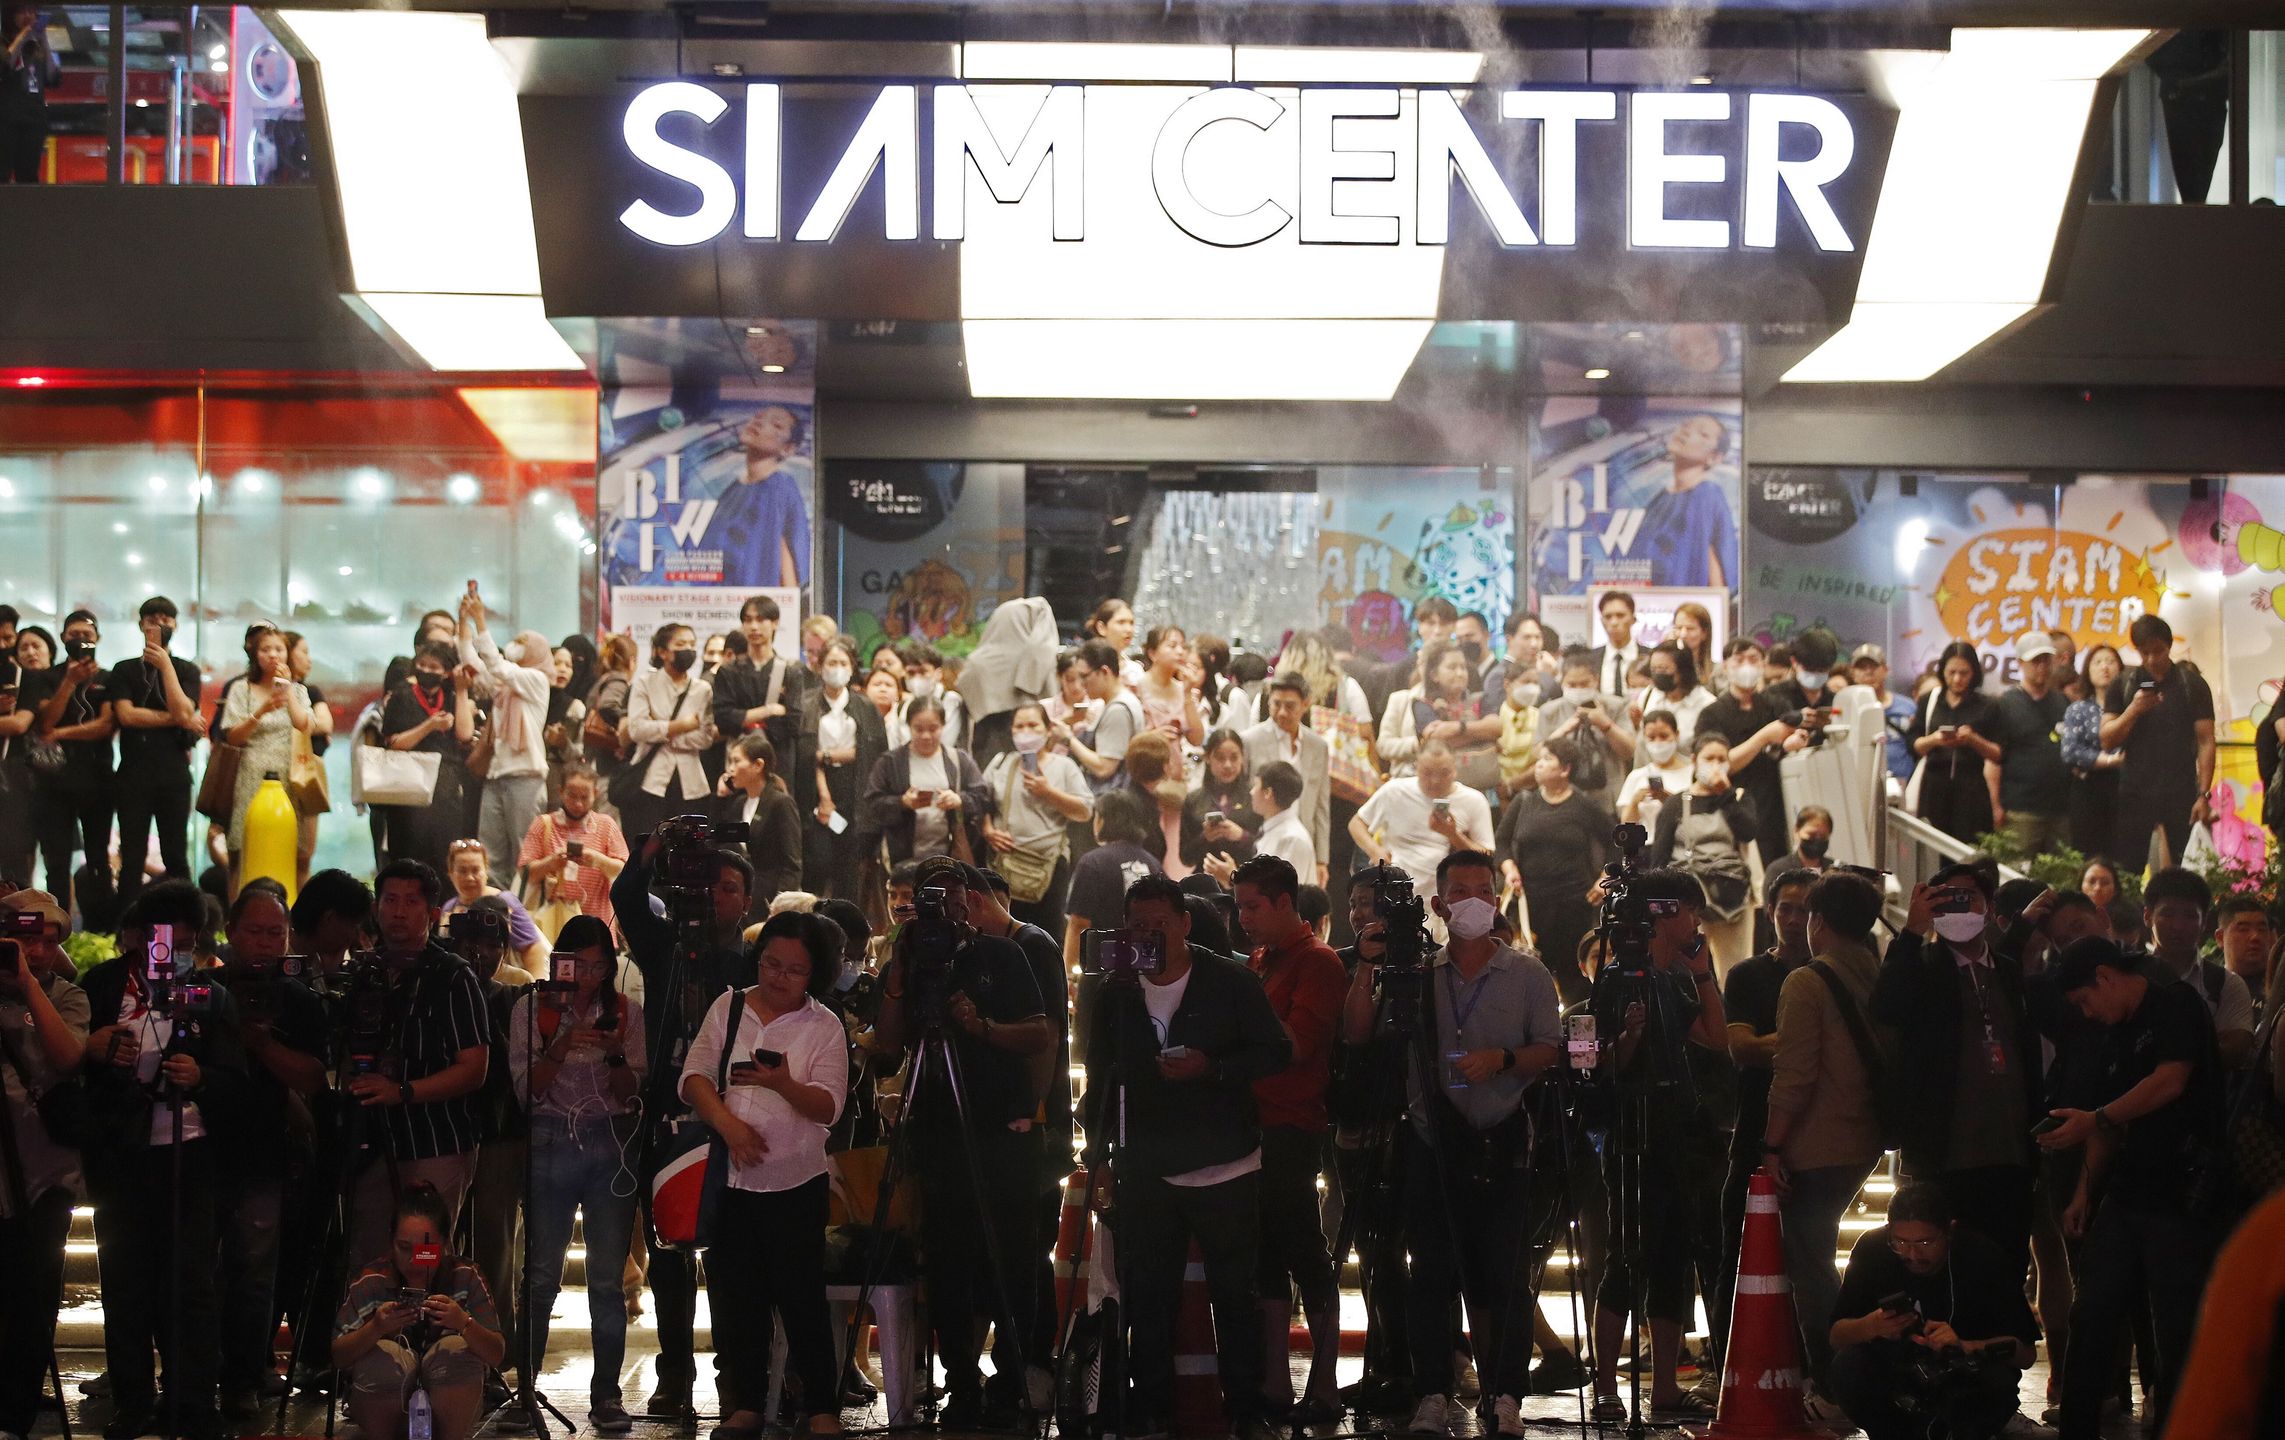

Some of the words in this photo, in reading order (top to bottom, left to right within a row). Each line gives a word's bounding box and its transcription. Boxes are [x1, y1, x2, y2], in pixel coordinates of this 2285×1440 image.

[619, 82, 1086, 246] SIAM
[1151, 86, 1857, 254] CENTER
[1966, 538, 2122, 596] SIAM
[1966, 594, 2146, 642] CENTER
